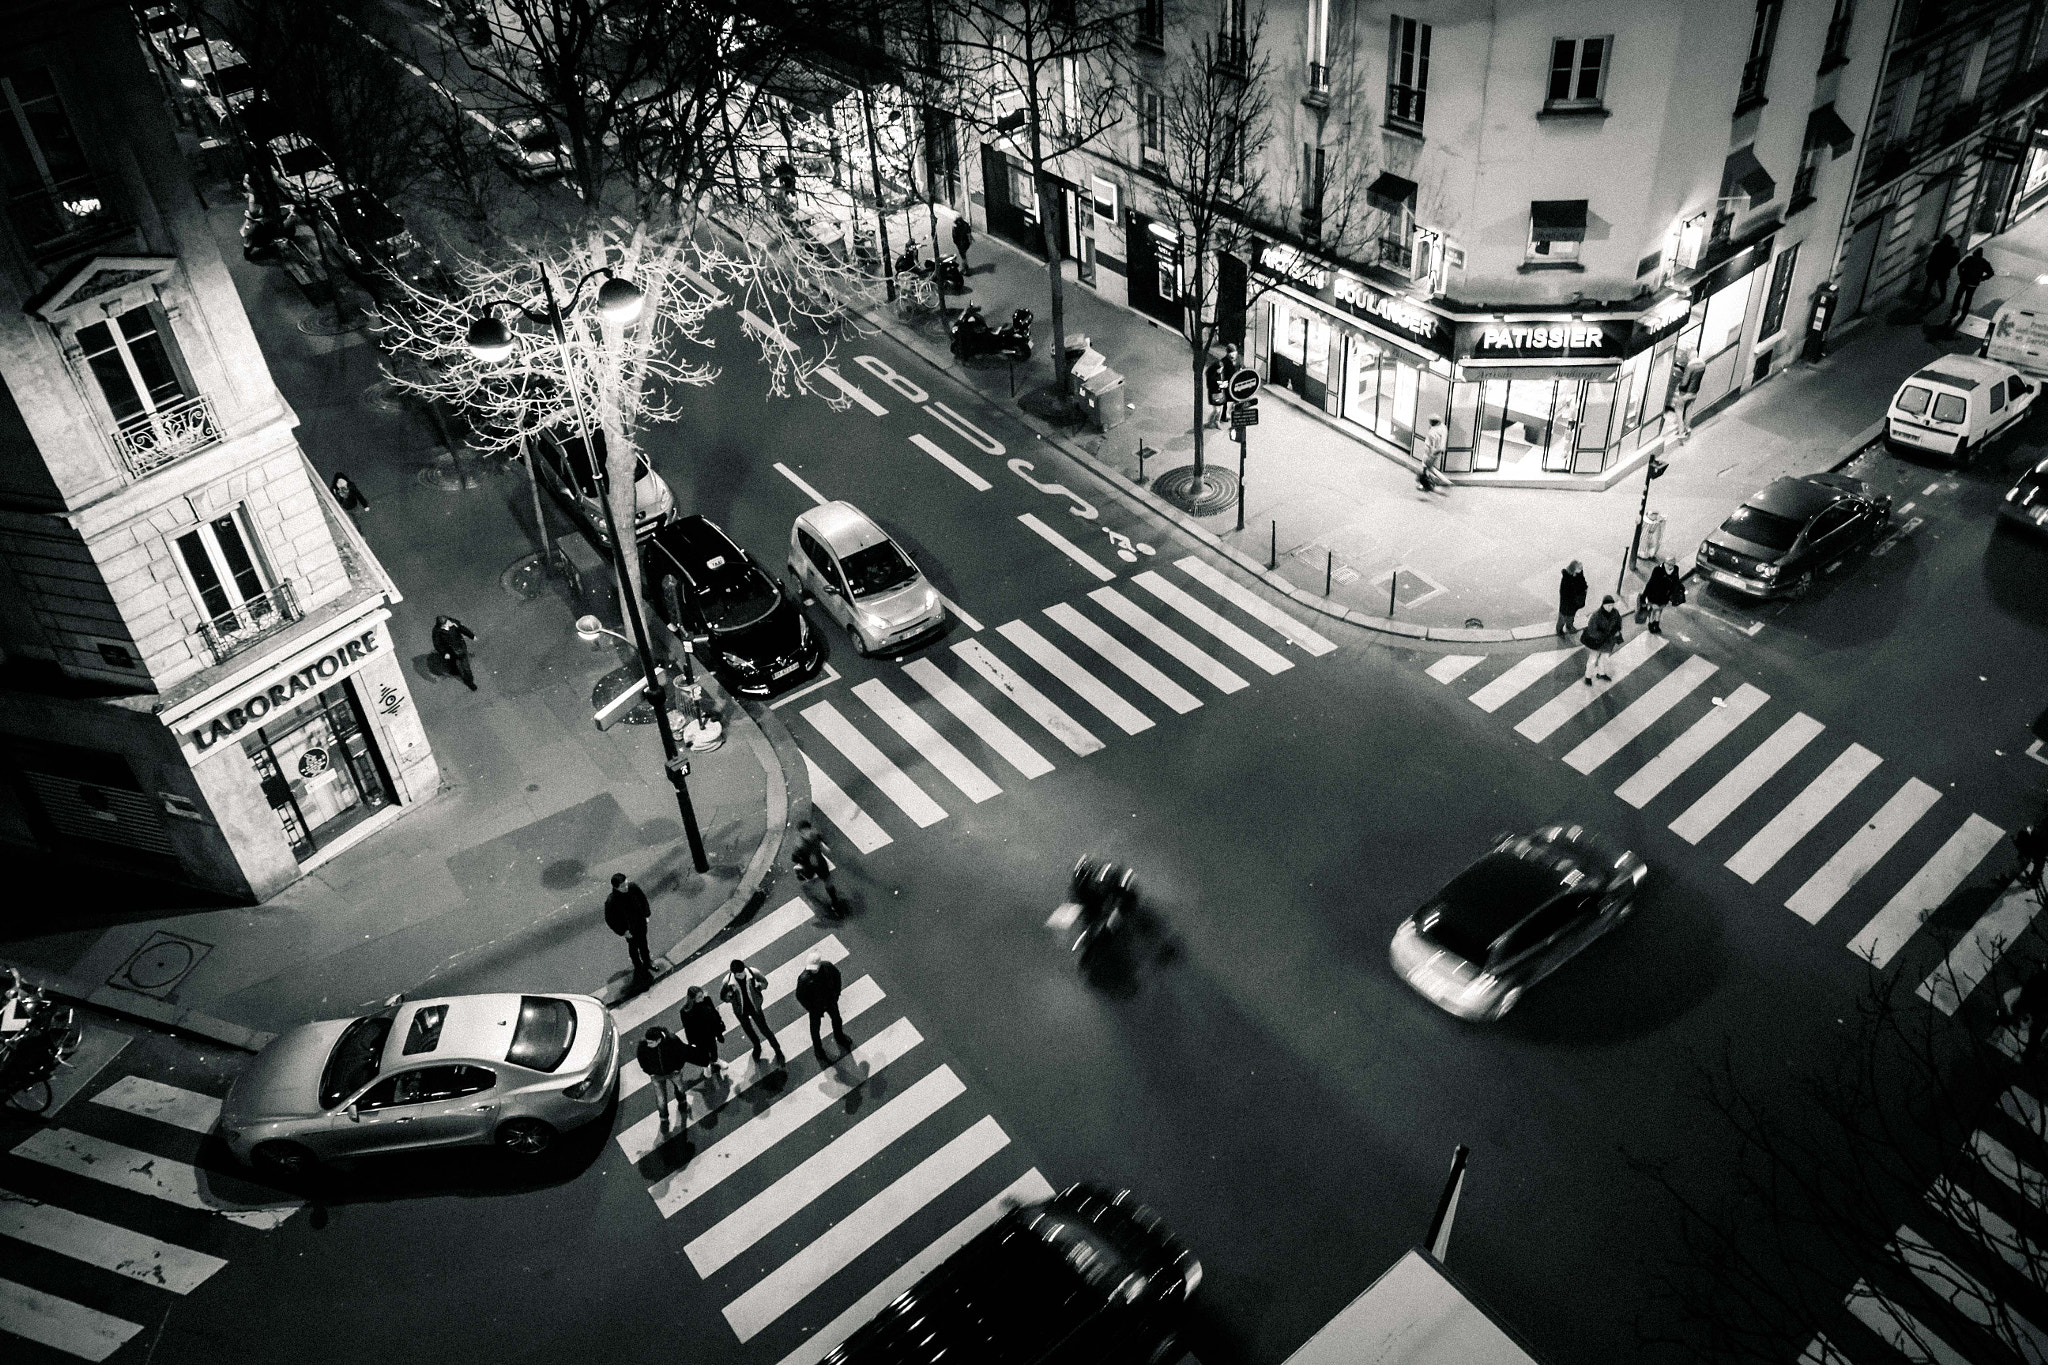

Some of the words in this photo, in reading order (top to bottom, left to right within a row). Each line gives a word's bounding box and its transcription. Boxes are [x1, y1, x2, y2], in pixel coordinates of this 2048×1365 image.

[1334, 278, 1436, 339] BOULANGER
[1484, 327, 1603, 349] PATISSIER
[853, 355, 1099, 520] BUS
[194, 630, 379, 750] LABORATOIRE
